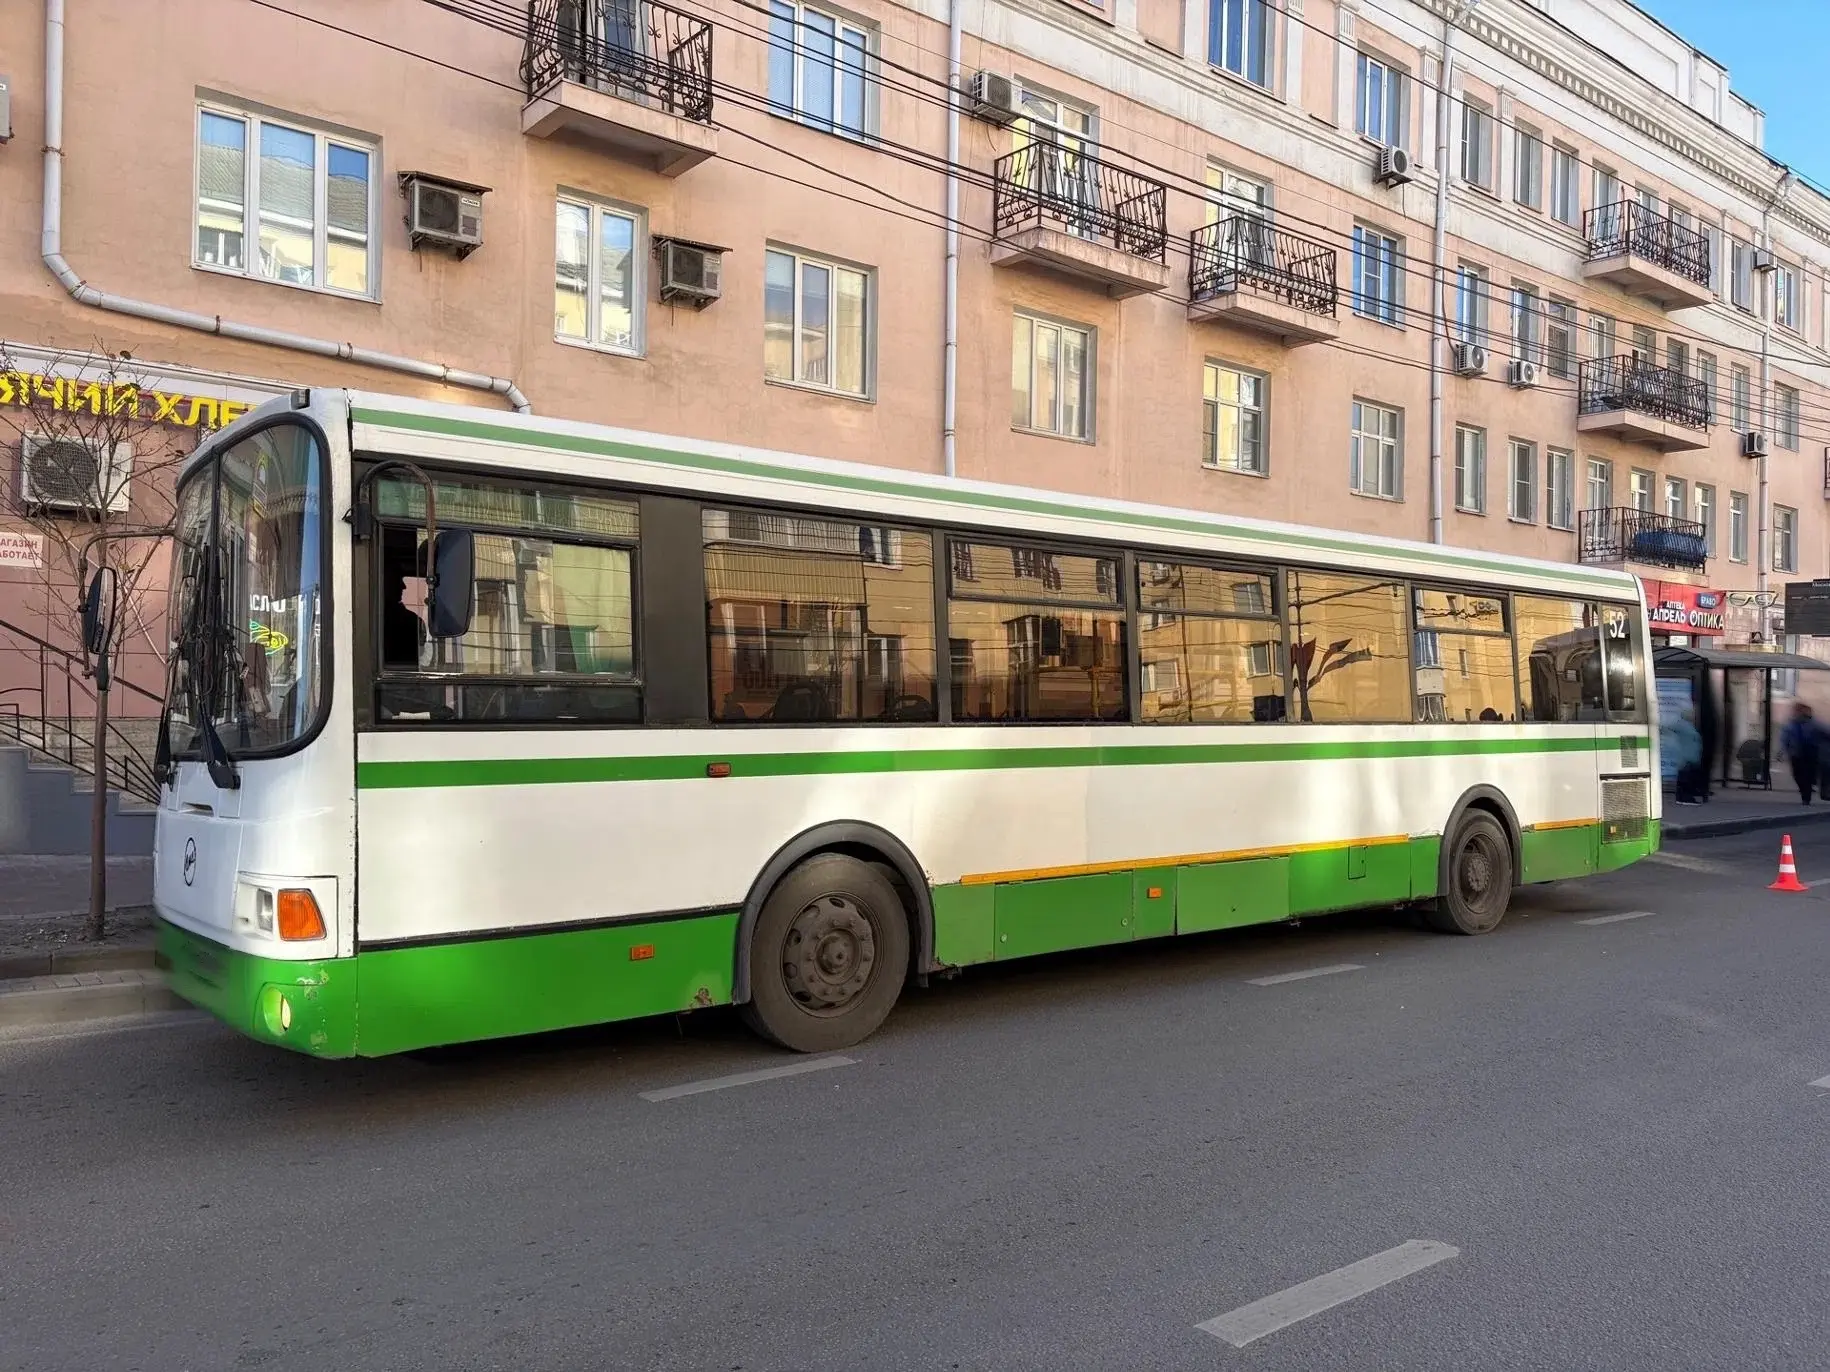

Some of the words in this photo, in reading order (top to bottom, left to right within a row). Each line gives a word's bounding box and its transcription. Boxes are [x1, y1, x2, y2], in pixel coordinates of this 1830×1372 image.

[151, 390, 256, 430] ХЛЕ
[0, 549, 40, 560] БОТАЕТ
[1609, 610, 1626, 638] 52
[1652, 608, 1686, 623] АПРЕЛЬ
[1689, 610, 1724, 629] ОПТИКА
